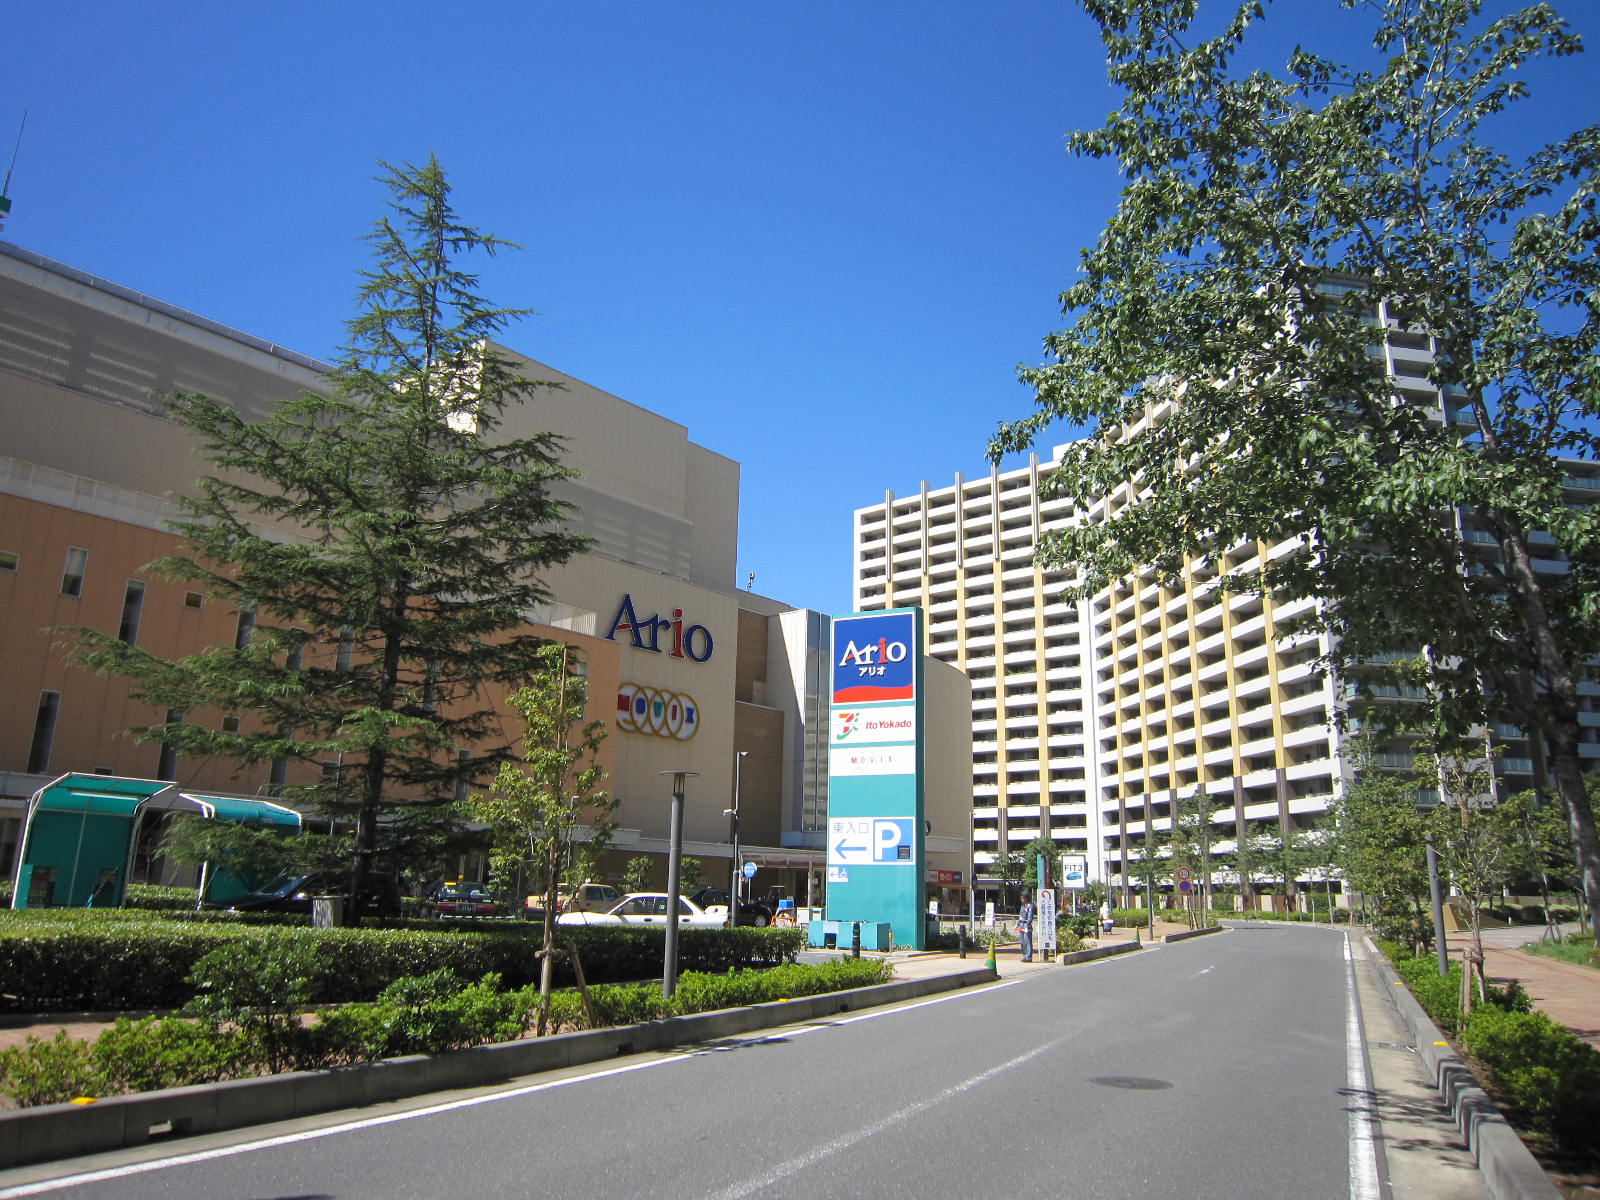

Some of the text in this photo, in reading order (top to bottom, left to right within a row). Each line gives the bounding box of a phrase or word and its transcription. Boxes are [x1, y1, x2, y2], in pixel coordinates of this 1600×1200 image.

[604, 593, 714, 663] Ario
[839, 637, 907, 667] Ario
[859, 666, 886, 677] アリオ
[617, 693, 695, 724] MOVIX
[833, 822, 869, 834] 東入口
[875, 822, 902, 860] P
[1064, 864, 1083, 872] FIT3
